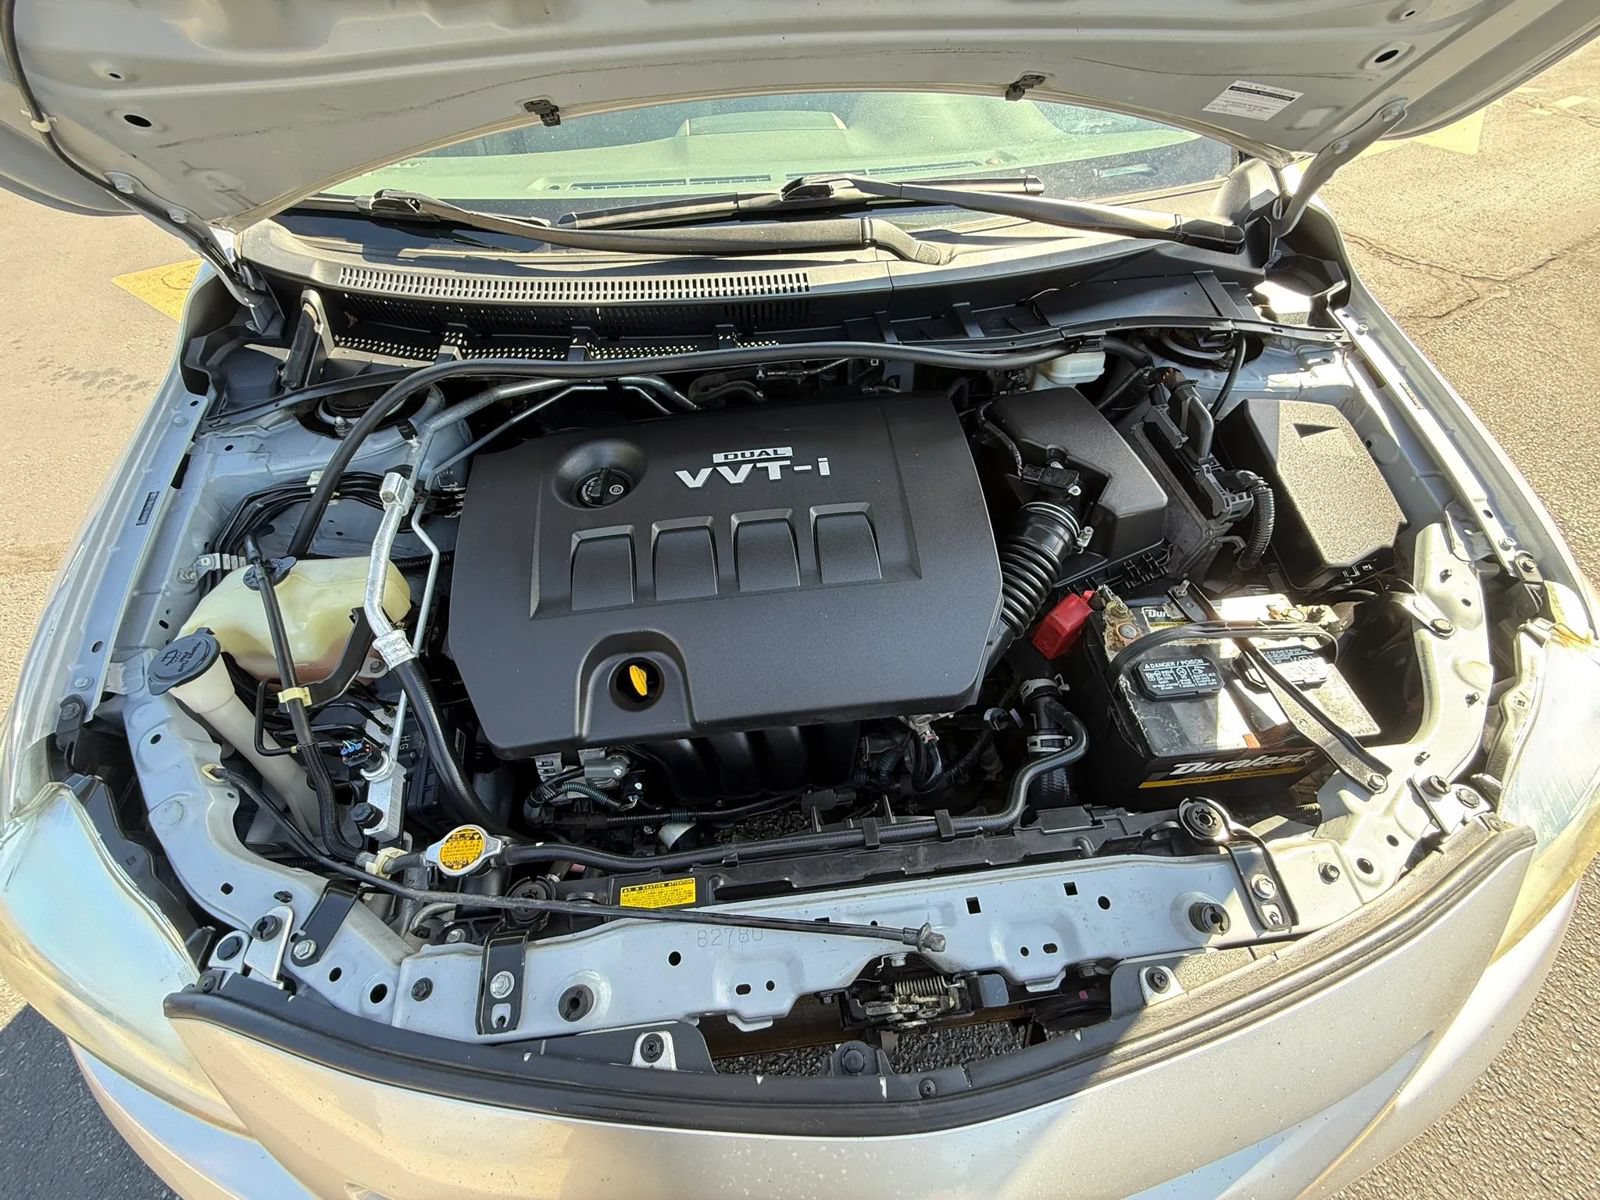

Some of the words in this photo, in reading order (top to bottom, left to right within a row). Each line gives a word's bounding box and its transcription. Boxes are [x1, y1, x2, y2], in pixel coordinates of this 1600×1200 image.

[723, 449, 787, 461] DUAL
[675, 457, 831, 489] VVT-i
[1169, 750, 1315, 776] Duralast
